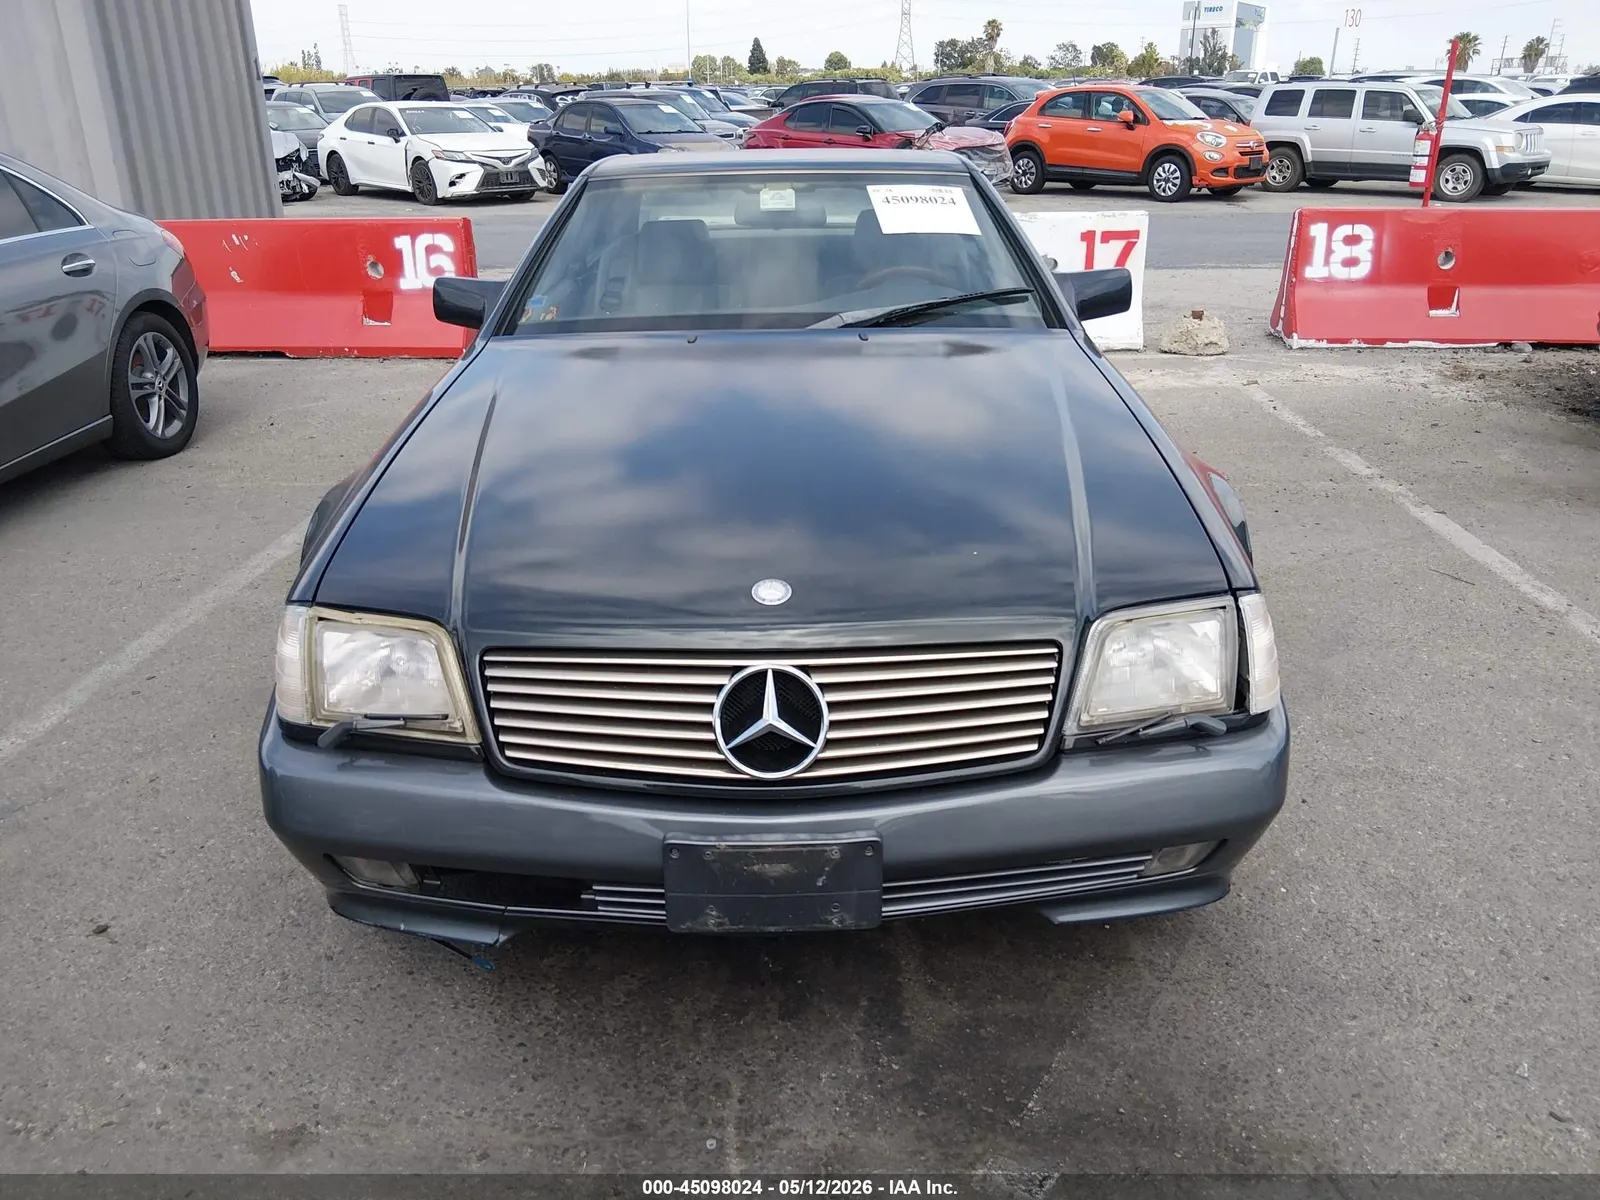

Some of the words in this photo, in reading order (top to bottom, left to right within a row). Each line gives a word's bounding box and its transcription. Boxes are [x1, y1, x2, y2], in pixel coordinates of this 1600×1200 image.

[1344, 9, 1362, 27] 130
[882, 195, 957, 206] 45098024
[394, 233, 456, 290] 16
[1080, 230, 1140, 270] 17
[1304, 223, 1375, 280] 18
